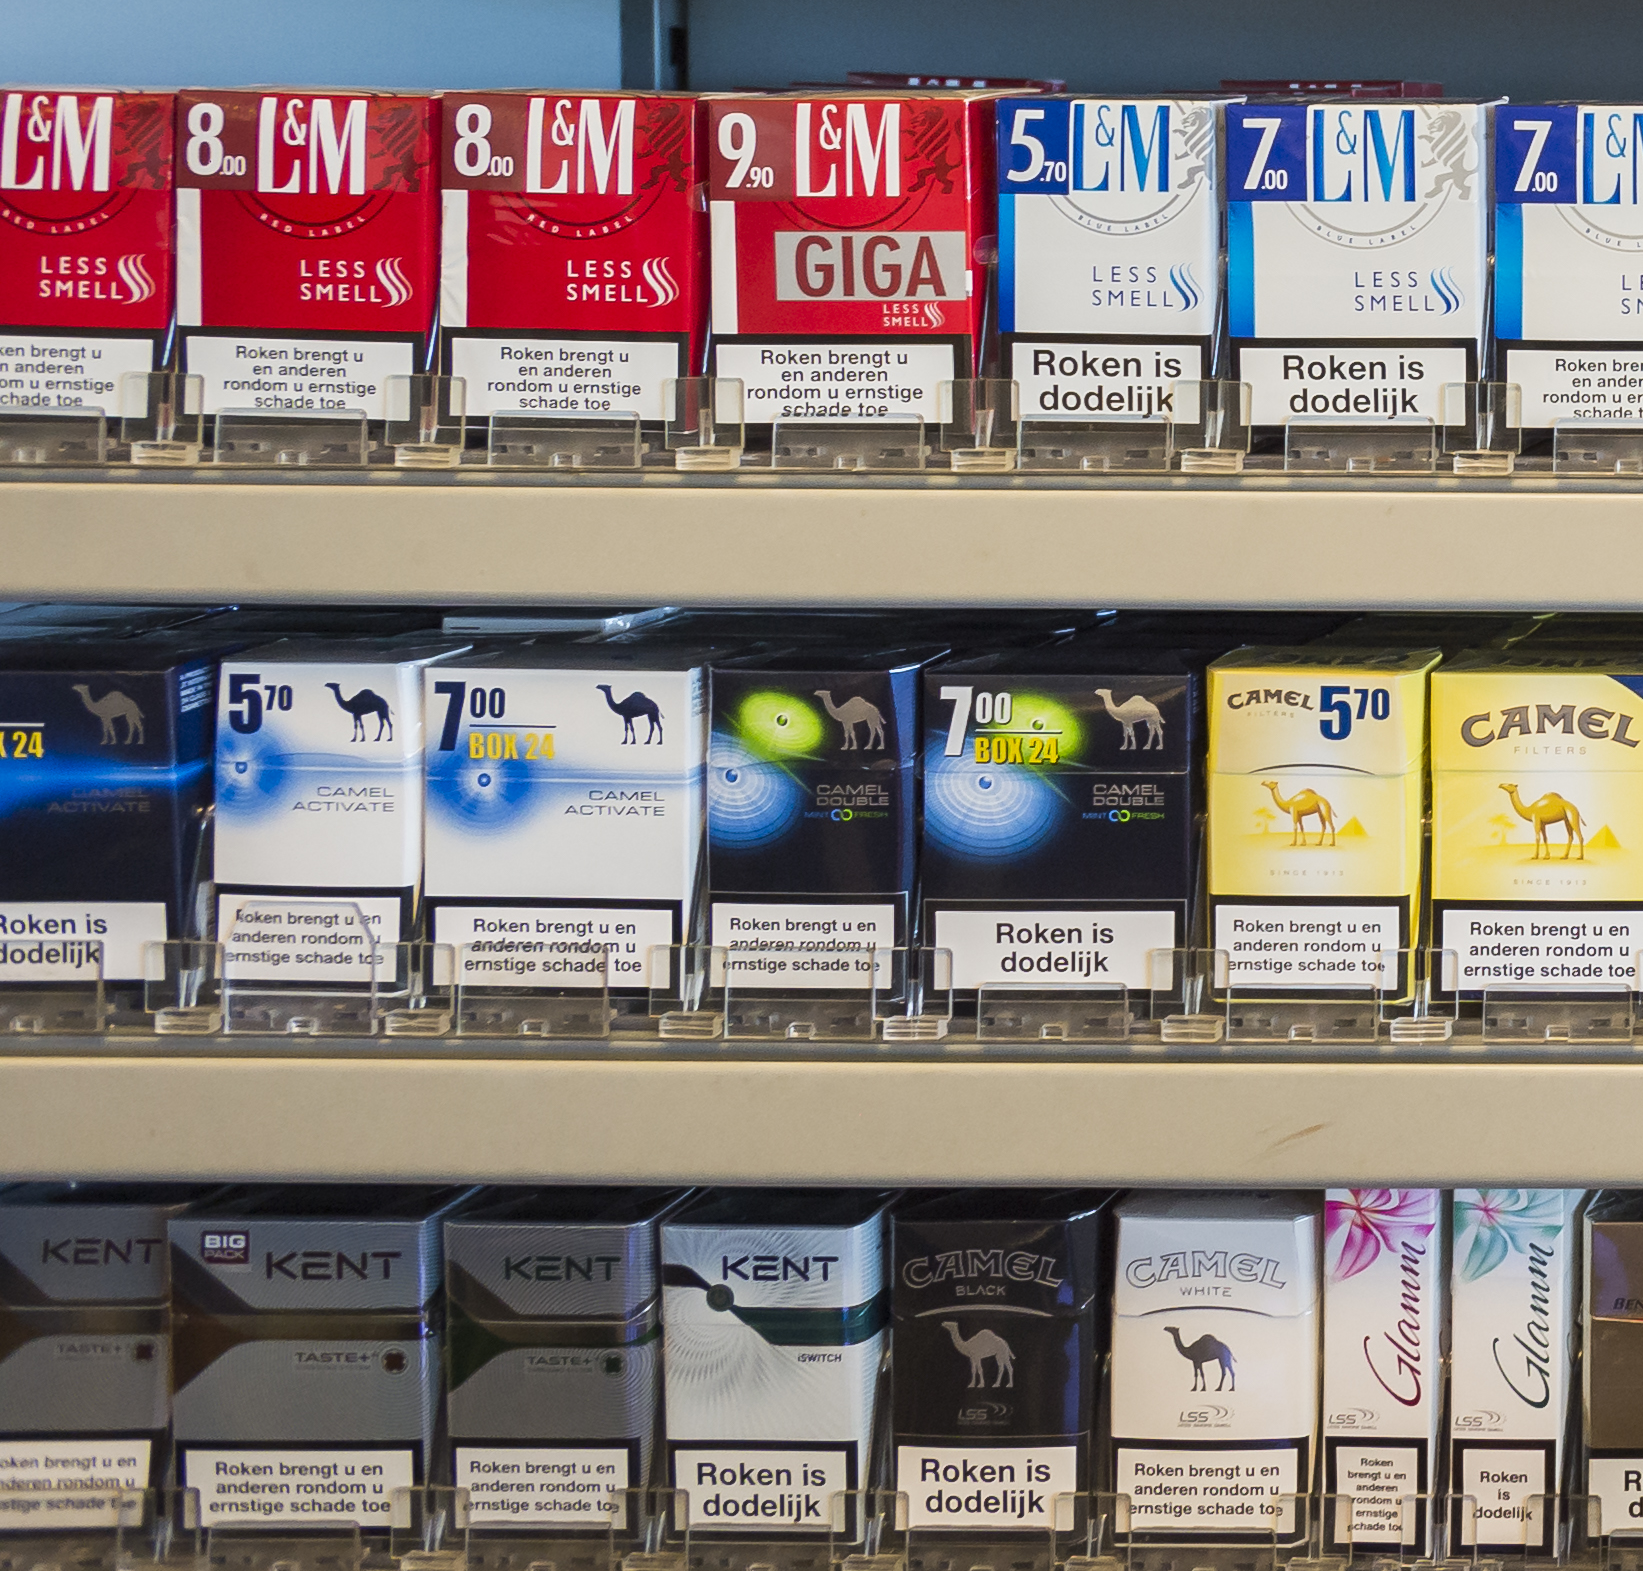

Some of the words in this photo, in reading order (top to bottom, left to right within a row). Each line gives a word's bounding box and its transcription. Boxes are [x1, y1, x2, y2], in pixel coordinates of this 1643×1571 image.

[258, 97, 367, 195] L&M
[797, 104, 900, 197] L&M
[301, 260, 365, 278] LESS
[795, 236, 947, 297] GIGA
[301, 284, 381, 303] SMELL
[1227, 689, 1315, 712] CAMEL
[1461, 704, 1640, 748] CAMEL
[975, 738, 1023, 764] BOX
[1029, 738, 1059, 764] 24
[1514, 746, 1587, 755] FILTERS
[589, 791, 665, 802] CAMEL
[565, 804, 665, 816] ACTIVATE
[1470, 922, 1526, 936] Roken
[1531, 922, 1586, 939] brengt
[1594, 926, 1603, 936] u
[1609, 925, 1629, 936] en
[1469, 943, 1540, 957] anderen
[1546, 943, 1611, 957] rondom
[1619, 946, 1629, 956] u
[1464, 963, 1535, 979] ernstige
[1541, 963, 1603, 977] schade
[1609, 964, 1635, 977] toe
[205, 1234, 246, 1250] BIG
[266, 1252, 401, 1279] KENT
[723, 1256, 839, 1281] KENT
[903, 1250, 1064, 1288] CAMEL
[1126, 1250, 1287, 1289] CAMEL
[956, 1285, 1006, 1296] BLACK
[1180, 1286, 1231, 1297] WHITE
[216, 1462, 272, 1476] Roken
[279, 1462, 339, 1480] brengt
[345, 1464, 355, 1476] u
[361, 1464, 383, 1476] en
